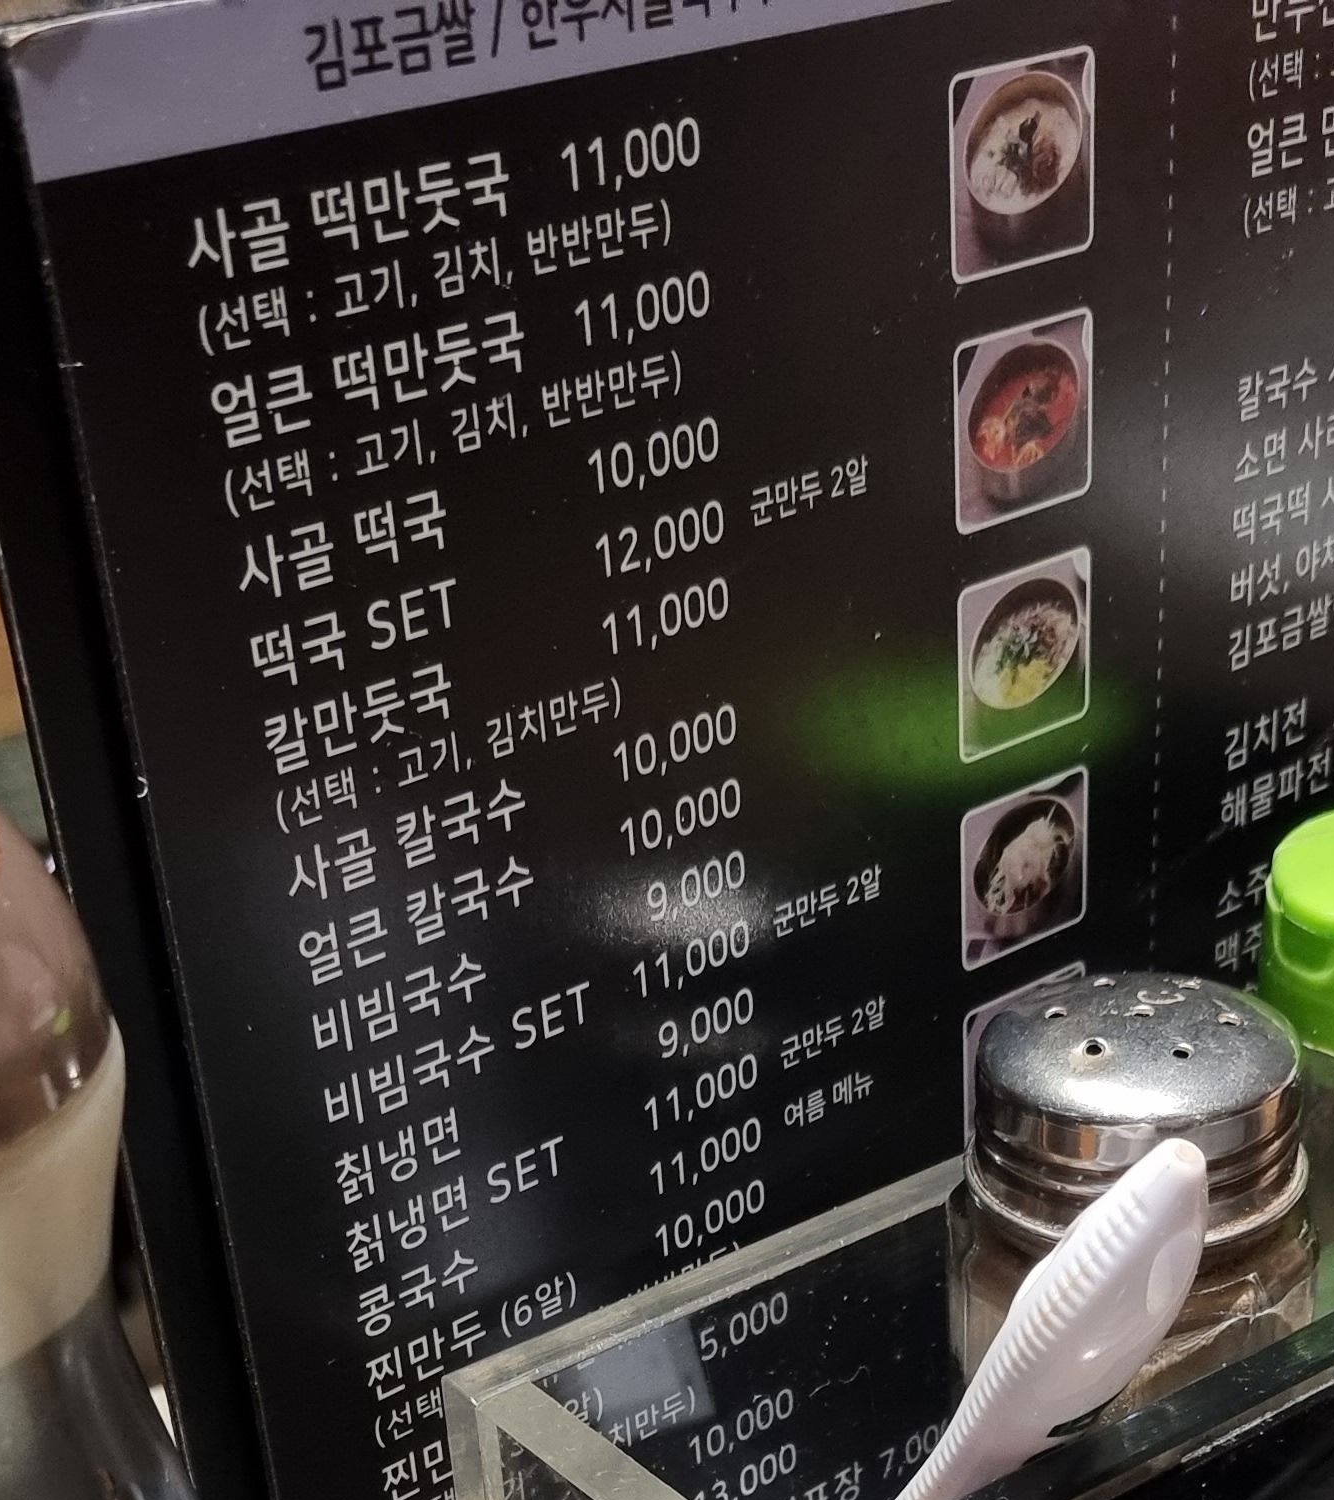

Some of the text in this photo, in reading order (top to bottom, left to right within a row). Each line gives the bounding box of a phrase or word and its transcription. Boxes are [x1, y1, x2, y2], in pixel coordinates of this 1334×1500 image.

[304, 2, 476, 92] 김포금쌀
[1249, 46, 1304, 102] (선택
[185, 116, 702, 281] 사골 떡만둣국 11,000
[1243, 185, 1298, 238] (선택
[1246, 112, 1308, 179] 얼큰
[197, 286, 290, 358] (선택
[333, 260, 418, 317] 고기,
[432, 235, 514, 296] 김치,
[526, 198, 673, 278] 반반만두)
[210, 270, 712, 451] 얼큰 떡만둣국 11,000
[223, 449, 314, 518] (선택
[355, 423, 437, 479] 고기,
[450, 395, 530, 457] 김치,
[541, 350, 683, 429] 반반만두)
[1237, 352, 1320, 423] 칼국수
[238, 416, 721, 598] 사골 떡국 10,000
[1232, 478, 1312, 546] 떡국떡
[1233, 427, 1290, 485] 소면
[249, 454, 869, 686] 떡국 SET 12,000 군만두 2알
[1230, 557, 1289, 608] 버섯,
[264, 576, 731, 776] 칼만둣국 11,000
[275, 775, 357, 836] (선택
[397, 730, 473, 789] 고기,
[485, 675, 623, 759] 김치만두)
[1224, 698, 1308, 773] 김치전
[287, 703, 738, 902] 사골 칼국수 10,000
[1220, 748, 1333, 829] 해물파전
[298, 777, 742, 986] 얼큰 칼국수 10,000
[311, 849, 747, 1053] 비빔국수 9,000
[323, 864, 883, 1126] 비빔국수 SET 11,000 군만두 2알
[335, 986, 755, 1206] 칡냉면 9,000
[345, 995, 887, 1274] 칡냉면 SET 11,000 군만두 2알
[355, 1071, 875, 1339] 콩국수 11,000 여름 메뉴
[366, 1309, 488, 1403] 찐만두
[500, 1270, 578, 1340] (6알)
[654, 1178, 767, 1258] 10,000
[698, 1290, 789, 1365] 5,000
[687, 1388, 795, 1466] 10,000
